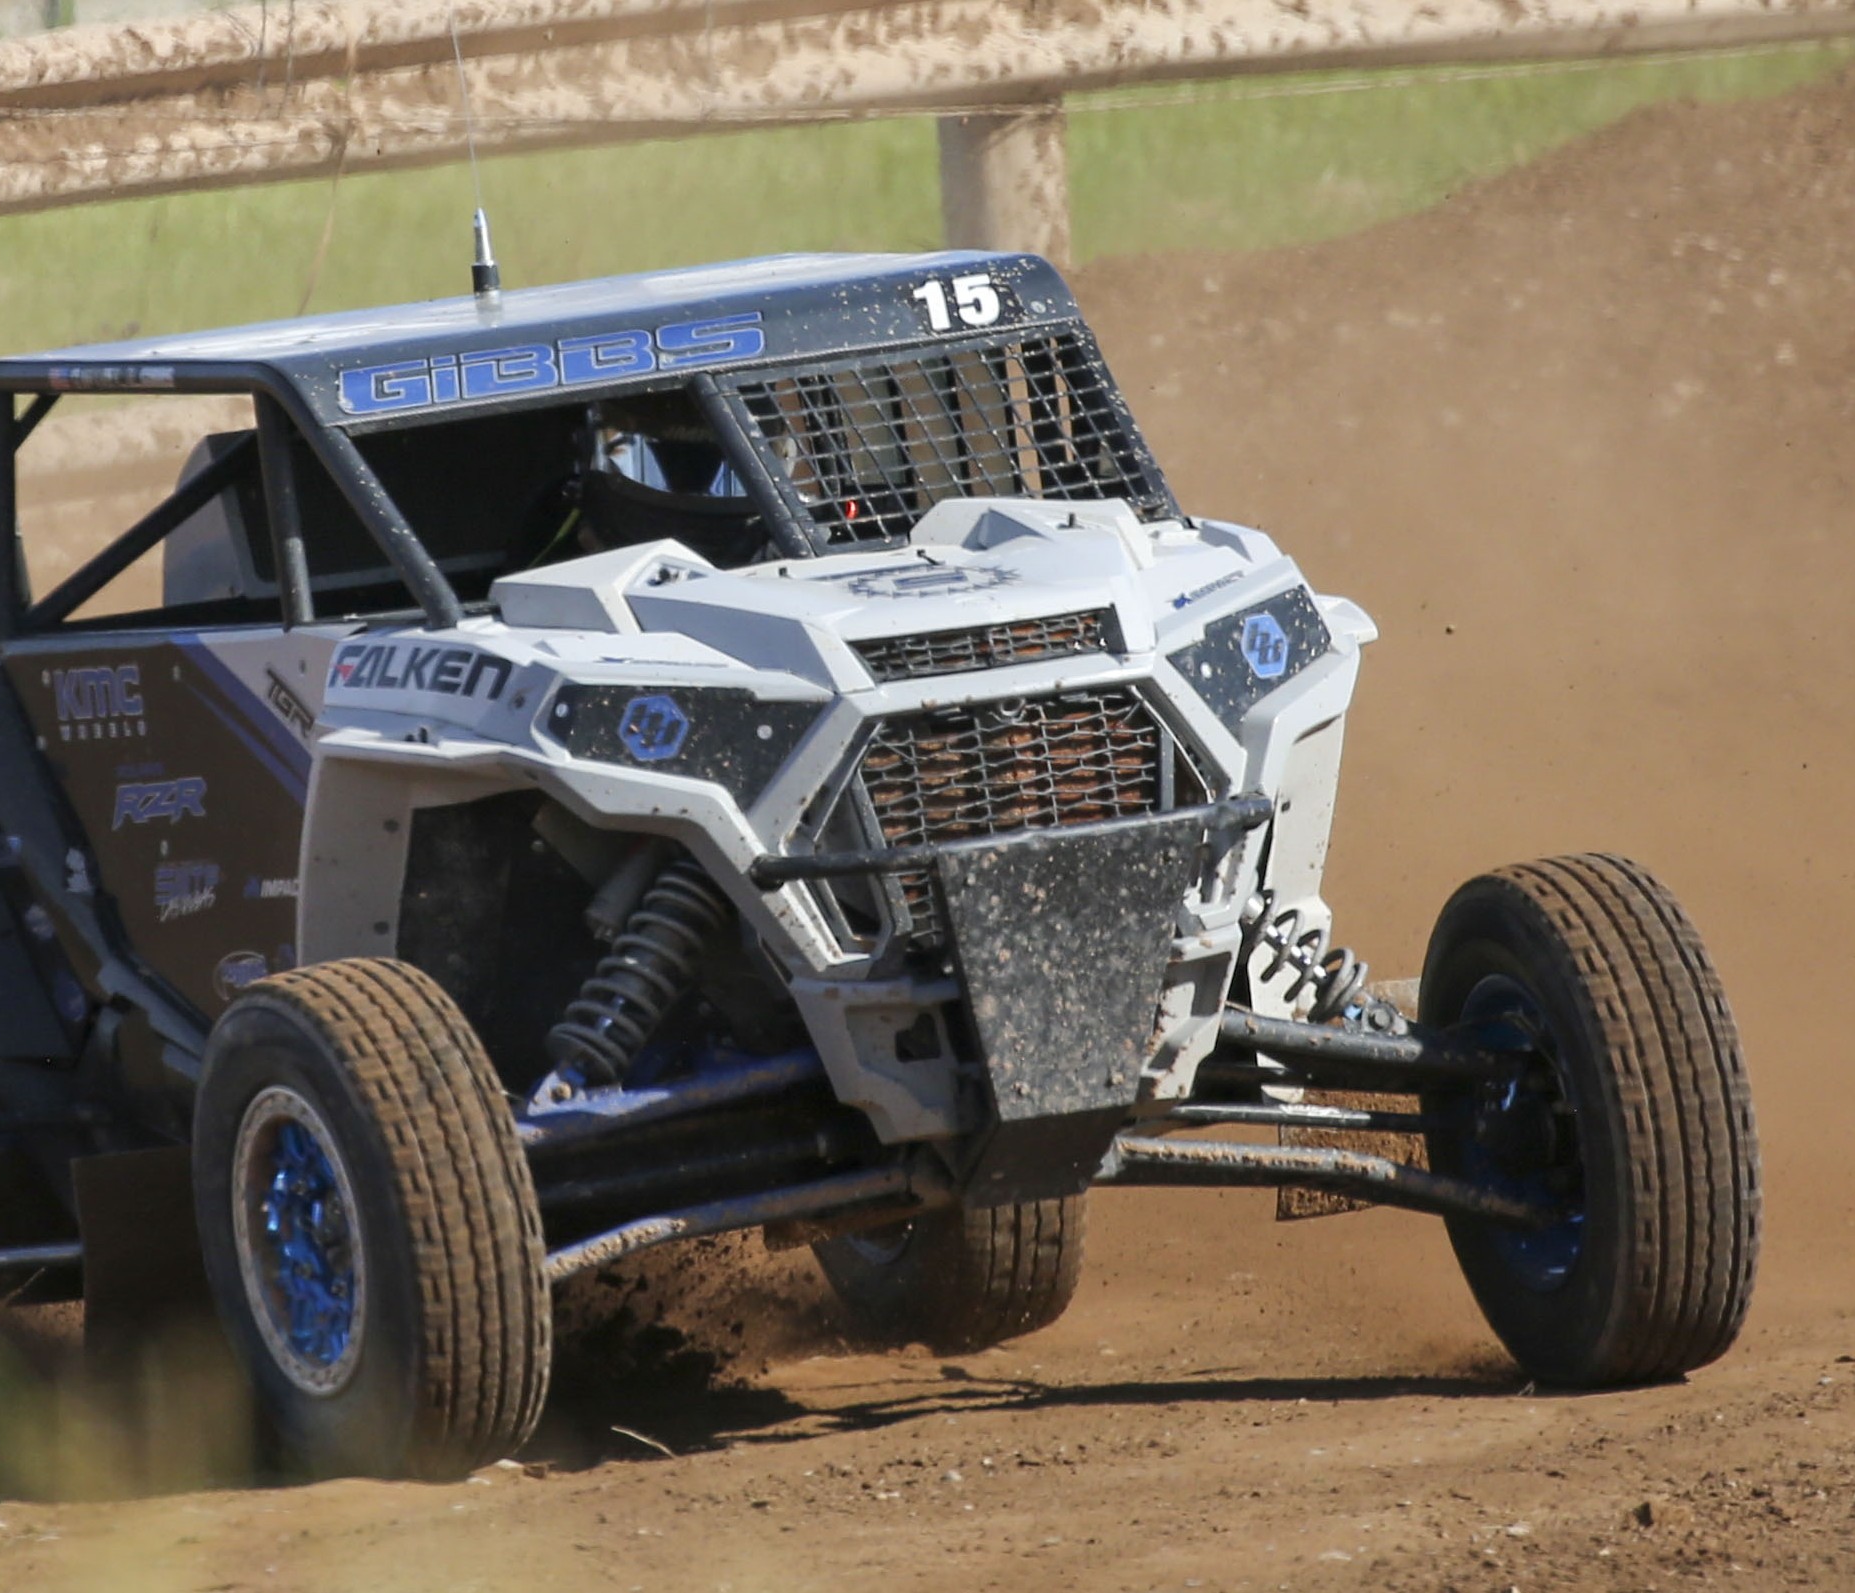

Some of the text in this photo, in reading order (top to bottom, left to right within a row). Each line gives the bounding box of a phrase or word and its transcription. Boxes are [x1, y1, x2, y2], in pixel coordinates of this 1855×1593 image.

[912, 272, 1001, 331] 15
[328, 644, 513, 701] FALKEN
[111, 776, 207, 832] RZR
